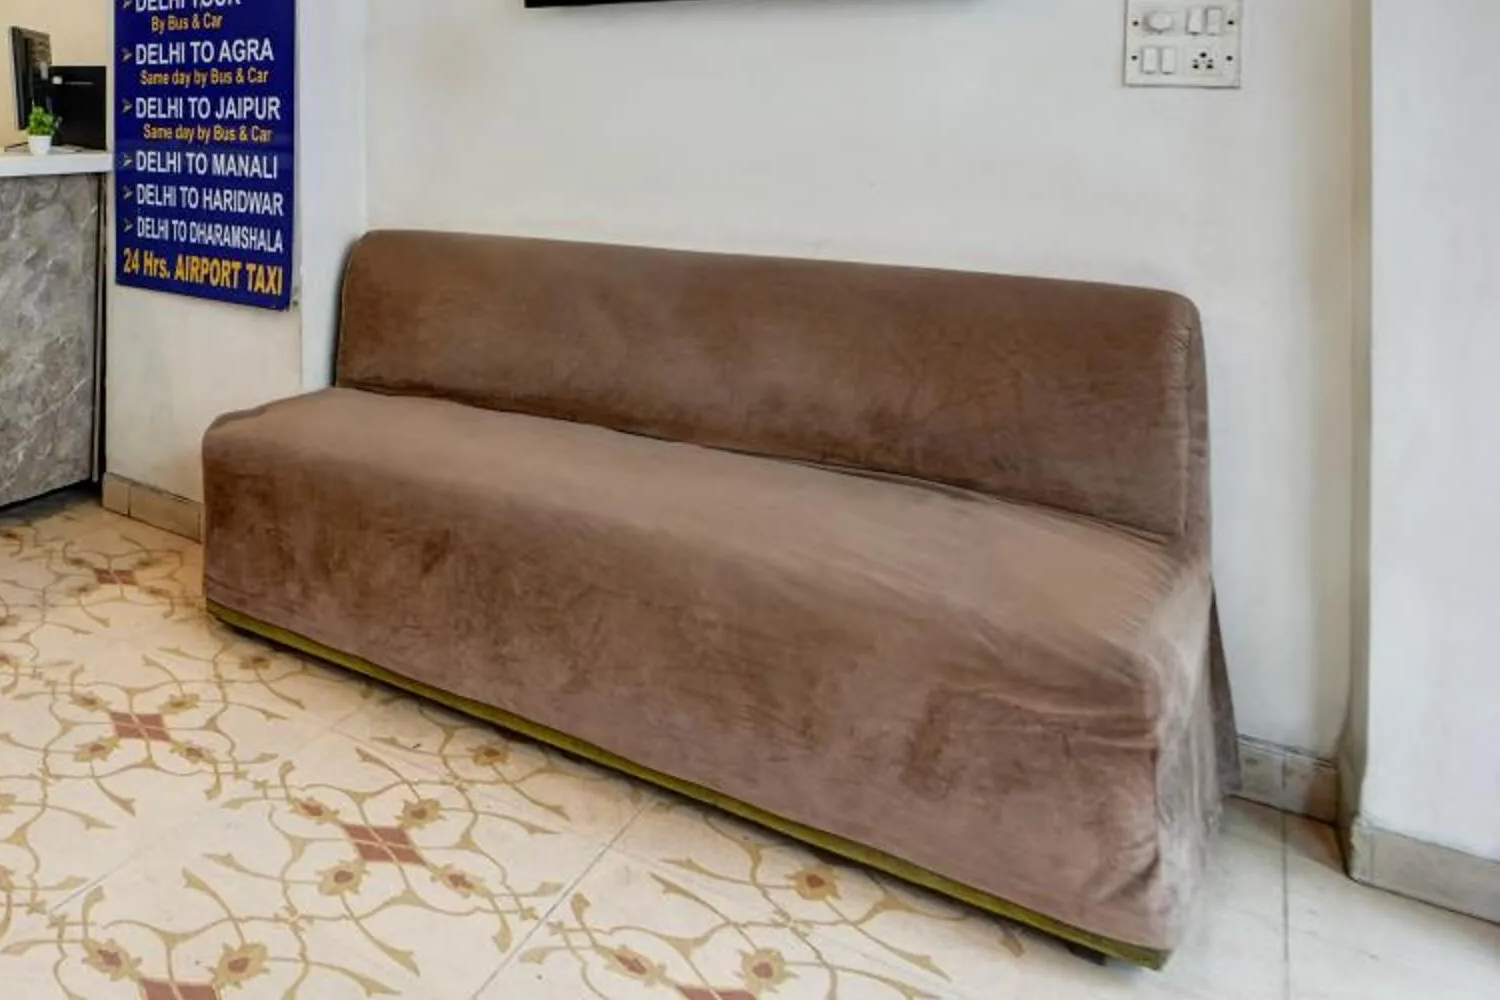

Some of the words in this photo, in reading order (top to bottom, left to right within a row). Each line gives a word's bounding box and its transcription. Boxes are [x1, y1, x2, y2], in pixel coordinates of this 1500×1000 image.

[151, 16, 165, 34] By
[168, 15, 189, 31] Bus
[192, 14, 200, 29] &
[203, 12, 223, 29] Car
[135, 42, 185, 65] DELHI
[190, 41, 214, 63] TO
[218, 37, 275, 63] AGRA
[140, 69, 169, 85] Same
[171, 69, 191, 88] day
[194, 68, 208, 88] by
[211, 68, 233, 84] Bus
[235, 67, 244, 83] &
[247, 67, 269, 83] Car
[135, 96, 183, 119] DELHI
[188, 96, 211, 119] TO
[215, 96, 281, 121] JAIPUR
[143, 123, 172, 139] Same
[175, 124, 195, 144] day
[198, 124, 211, 144] by
[214, 124, 236, 141] Bus
[239, 125, 248, 141] &
[251, 125, 272, 142] Car
[136, 151, 181, 173] DELHI
[185, 153, 208, 176] TO
[211, 153, 277, 179] MANALI
[136, 183, 176, 207] DELHI
[180, 186, 199, 209] TO
[202, 188, 284, 216] HARIDWAR
[137, 216, 169, 240] DELHI
[172, 218, 187, 242] TO
[189, 219, 283, 253] DHARAMSHALA
[123, 248, 140, 275] 24
[143, 251, 171, 279] Hrs.
[174, 254, 243, 289] AIRPORT
[245, 262, 283, 296] TAXI
